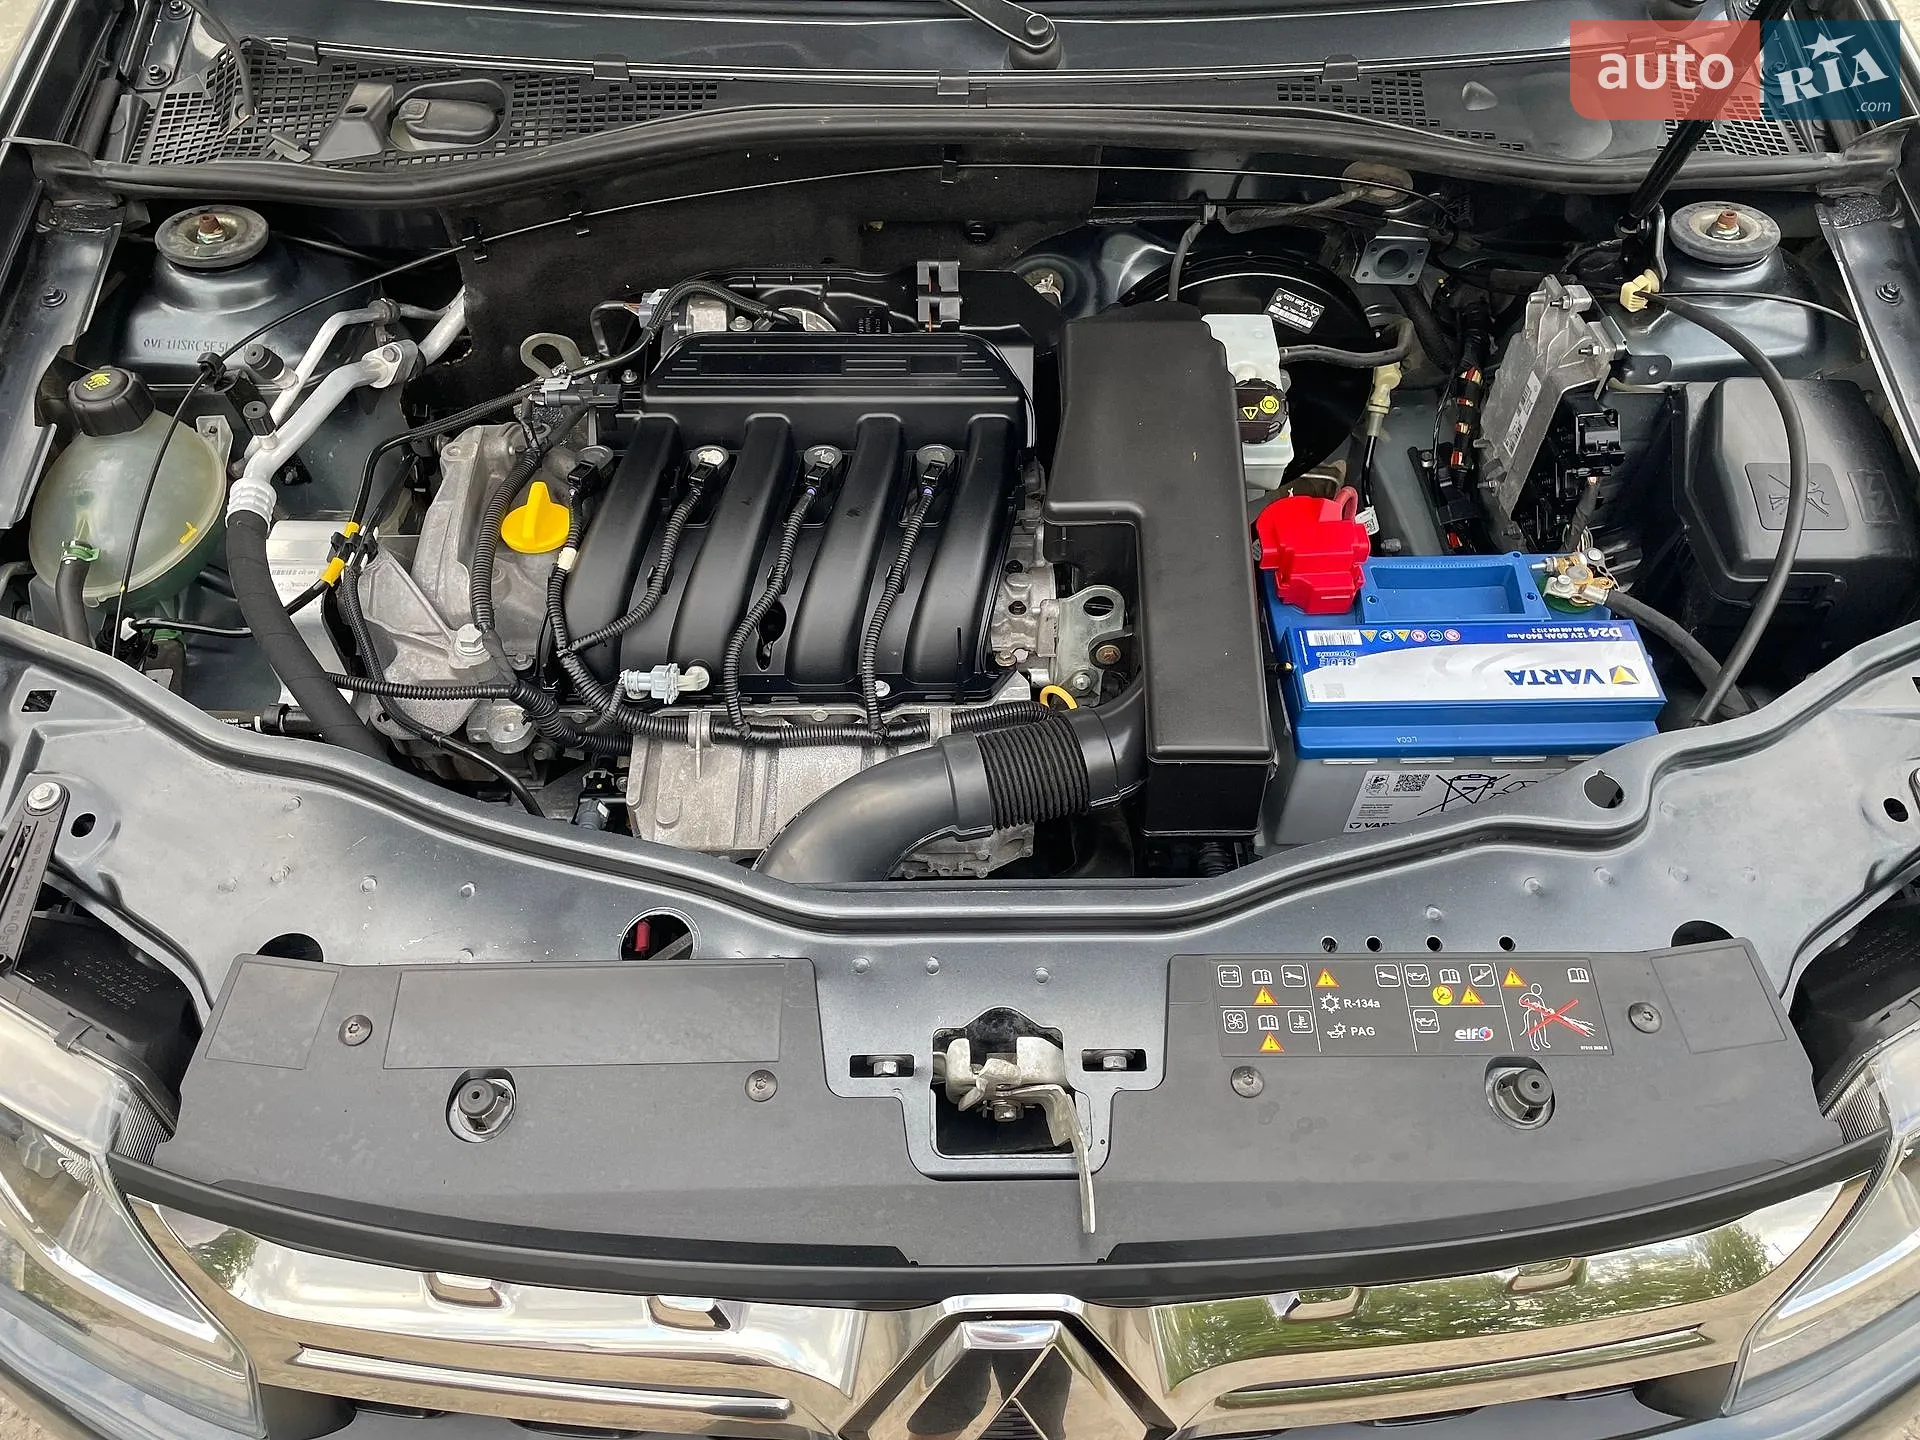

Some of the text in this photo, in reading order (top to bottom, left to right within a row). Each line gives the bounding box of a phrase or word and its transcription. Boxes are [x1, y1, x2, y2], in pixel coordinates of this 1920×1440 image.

[1588, 627, 1622, 638] D24
[1319, 657, 1357, 666] BLUE
[1504, 668, 1606, 686] VARTA
[1343, 998, 1381, 1009] R-134a
[1350, 1026, 1376, 1037] PAG
